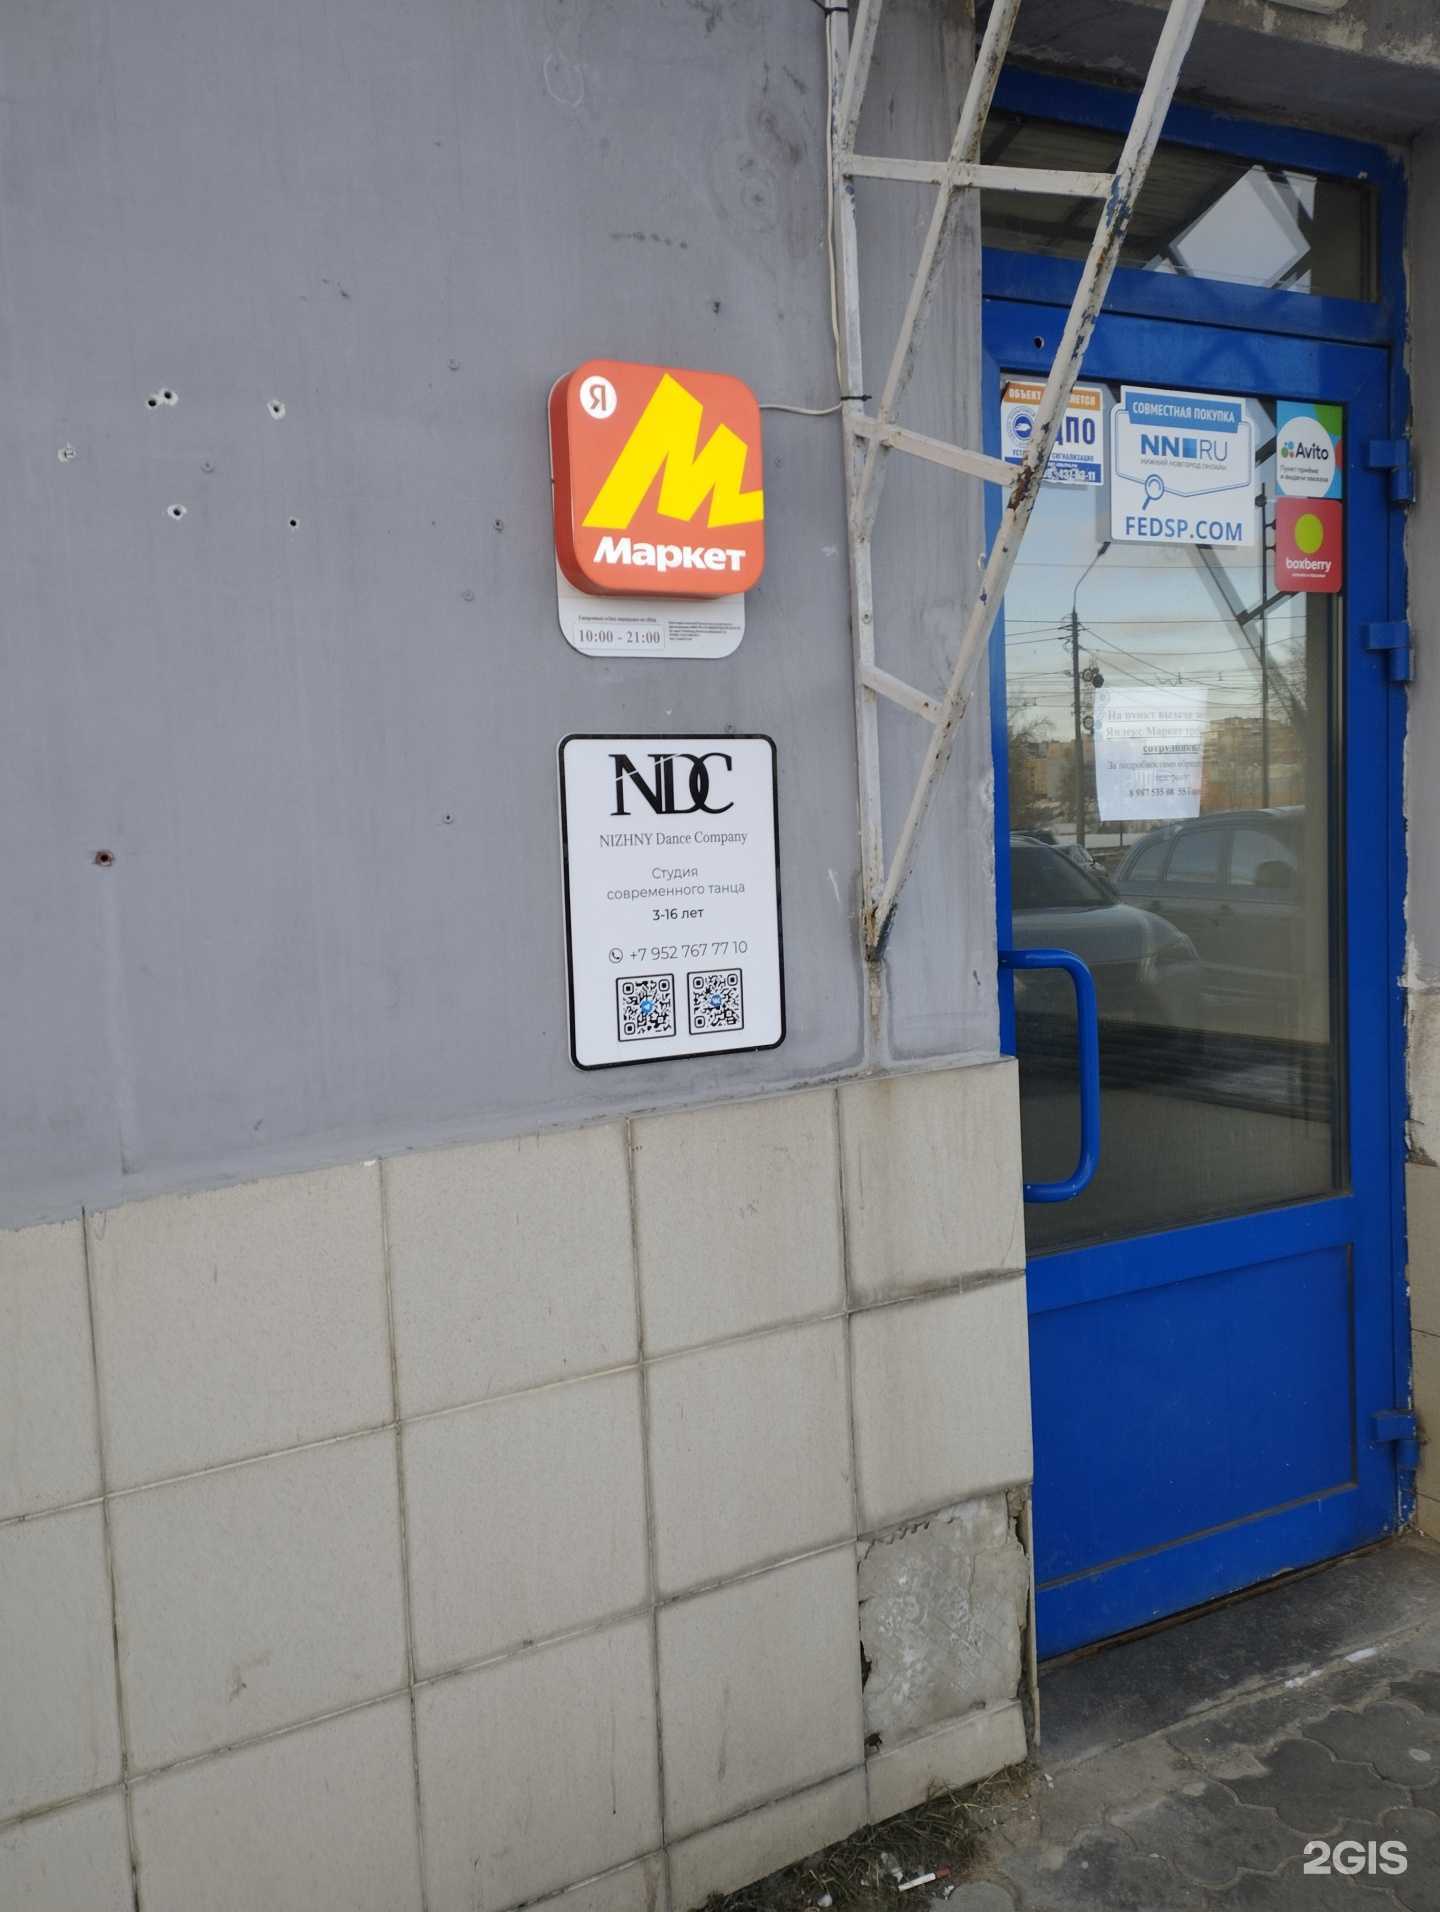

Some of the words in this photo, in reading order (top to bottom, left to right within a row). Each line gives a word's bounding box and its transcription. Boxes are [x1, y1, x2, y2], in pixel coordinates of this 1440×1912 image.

[1132, 401, 1192, 419] СОВМЕСТНАЯ
[1194, 408, 1236, 423] ПОКУПКА
[1141, 433, 1180, 458] NN
[1200, 439, 1228, 462] RU
[1296, 441, 1329, 460] Avito
[1125, 516, 1242, 541] FEDSP.COM
[592, 535, 746, 573] Маркет
[1286, 557, 1332, 573] boxberry
[578, 629, 613, 643] 10:00
[626, 630, 660, 644] 21:00
[608, 753, 735, 816] NDC
[600, 833, 653, 848] NIZHNY
[656, 832, 692, 846] Dance
[694, 830, 748, 845] Company
[651, 867, 699, 882] Студия
[606, 885, 705, 901] современного
[708, 881, 746, 895] танца
[652, 908, 679, 921] 3-16
[681, 908, 705, 920] лет
[629, 949, 647, 962] +7
[651, 946, 679, 961] 952
[681, 944, 708, 958] 767
[711, 942, 729, 956] 77
[733, 940, 749, 954] 10
